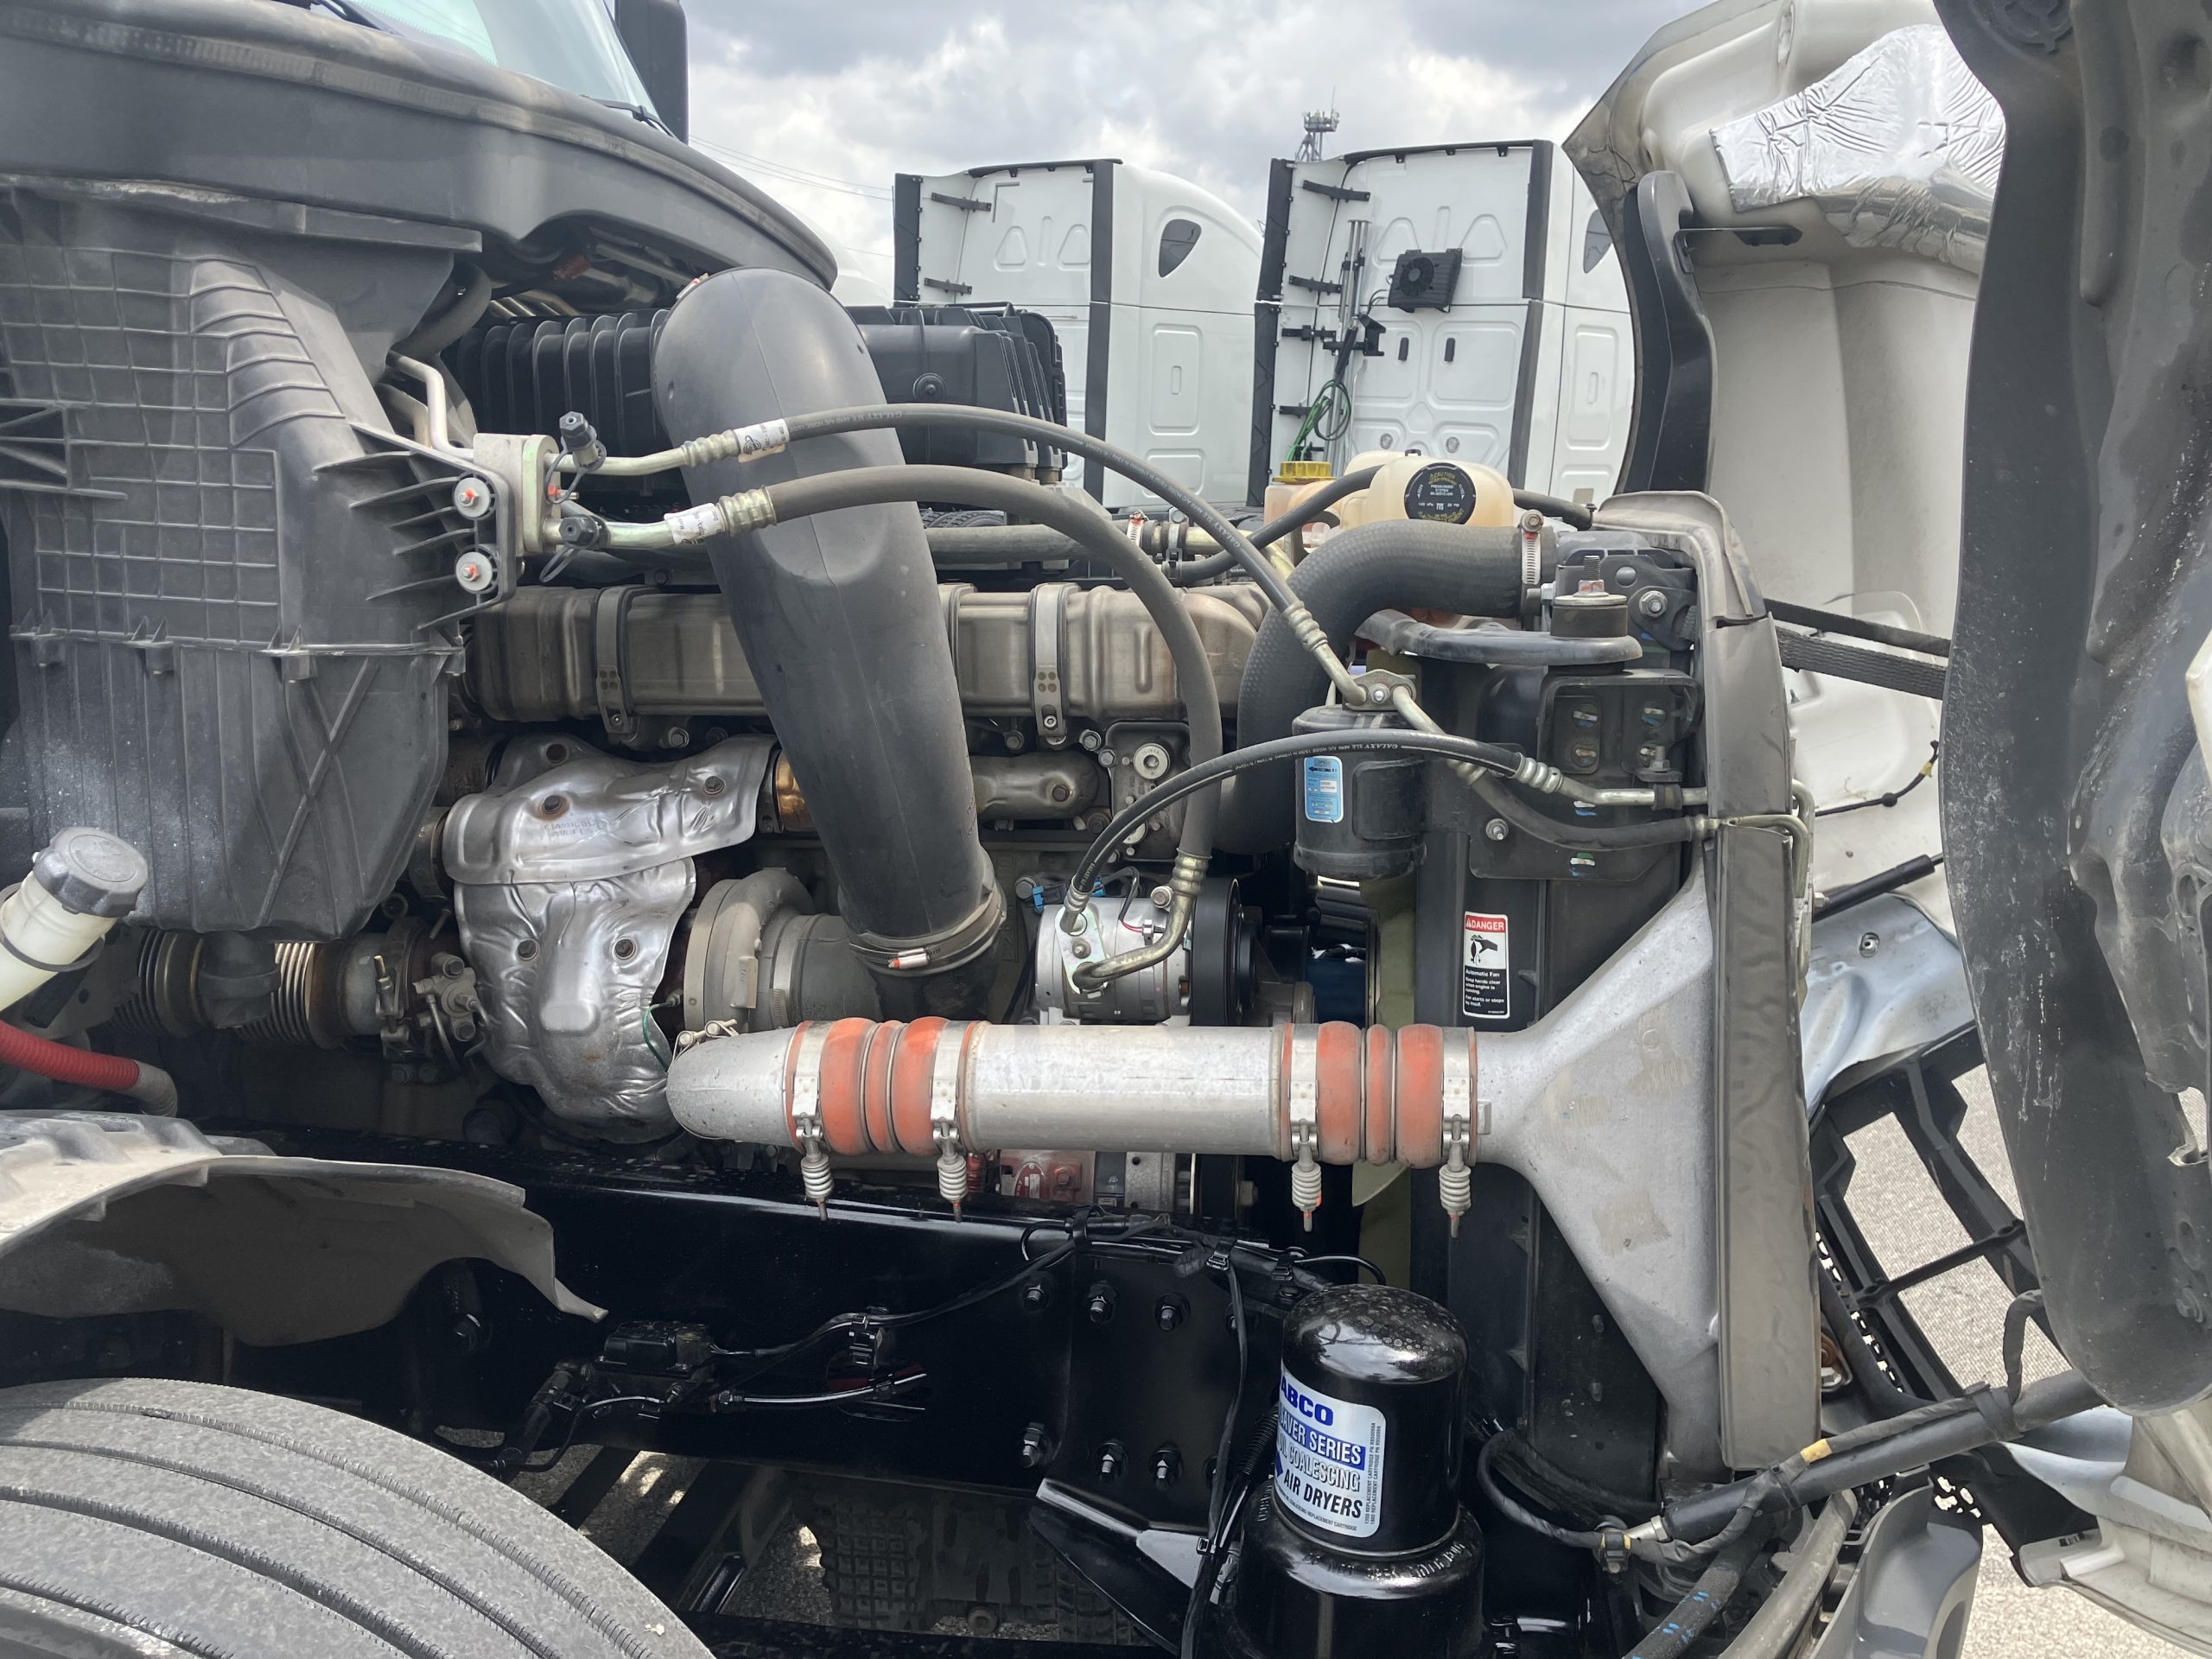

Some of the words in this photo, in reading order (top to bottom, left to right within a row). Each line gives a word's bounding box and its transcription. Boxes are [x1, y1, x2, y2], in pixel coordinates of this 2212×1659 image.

[1214, 522, 1241, 548] GALAXY
[1470, 920, 1504, 931] DANGER
[1309, 1430, 1362, 1465] SERIES
[1289, 1444, 1361, 1492] COALESCING
[1284, 1468, 1301, 1496] AIR
[1303, 1483, 1363, 1518] DRYERS
[1307, 1510, 1333, 1526] REPLACEMENT
[1333, 1521, 1357, 1532] CARTRIDGE
